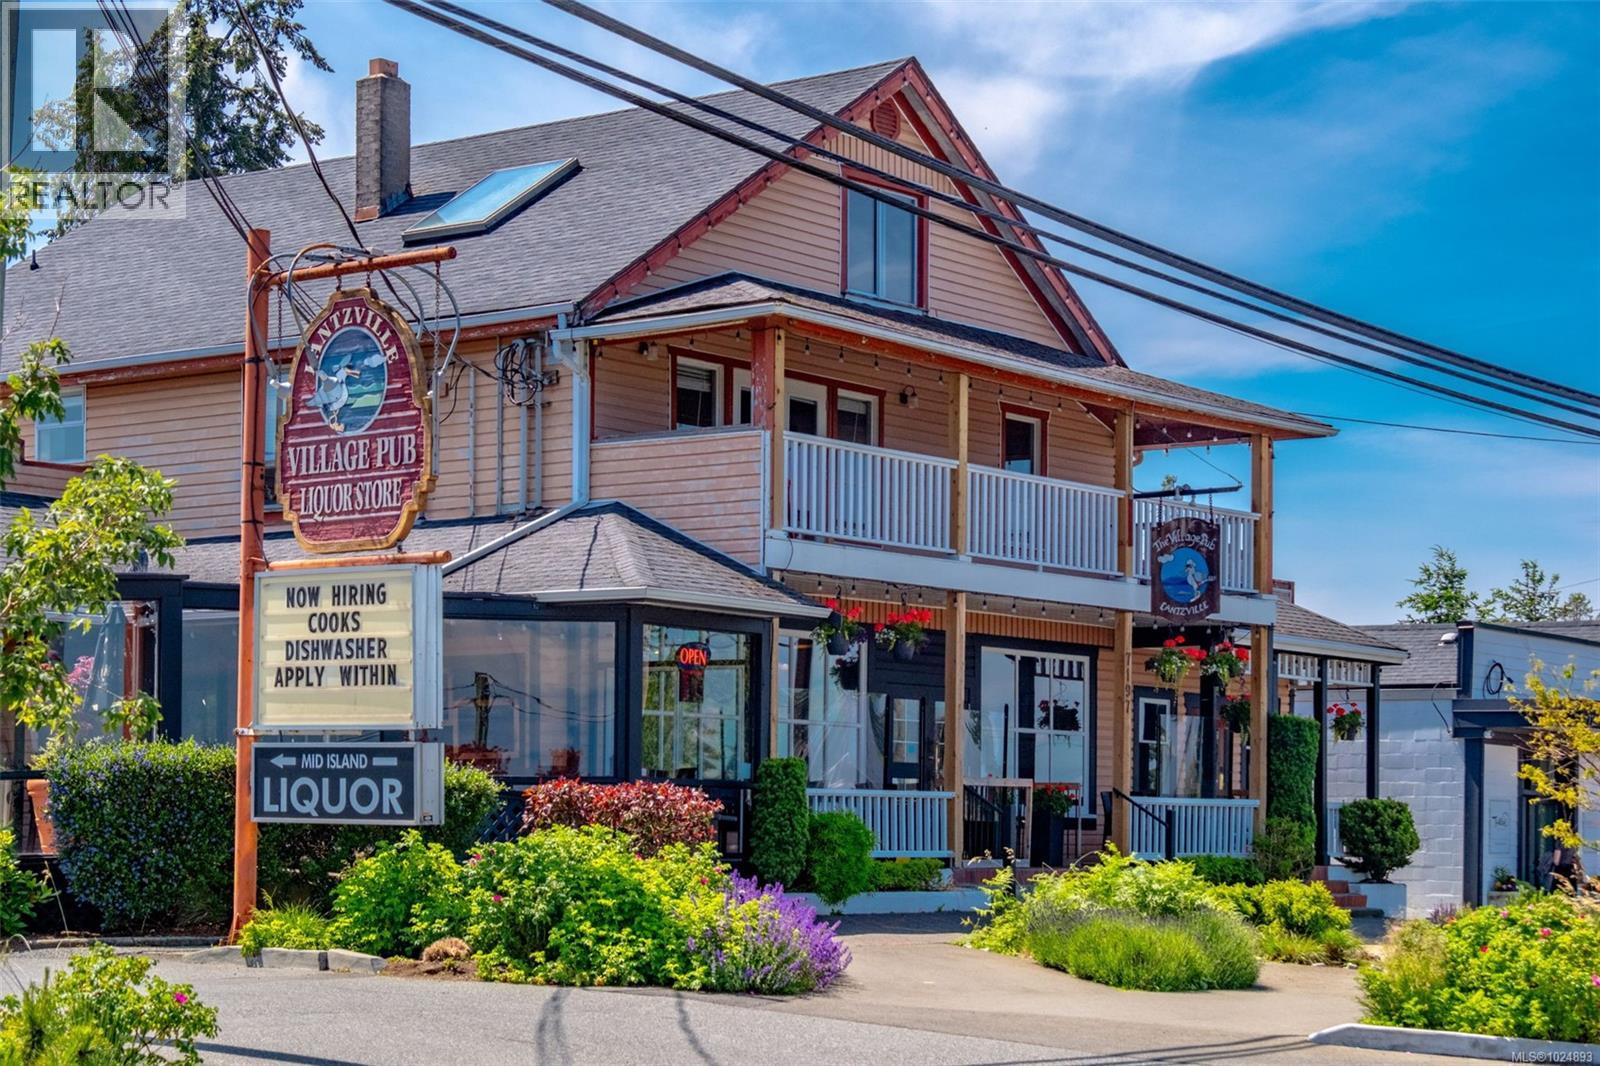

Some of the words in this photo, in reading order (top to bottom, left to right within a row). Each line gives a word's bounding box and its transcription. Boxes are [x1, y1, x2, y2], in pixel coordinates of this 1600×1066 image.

[287, 438, 370, 476] VILLAGE
[375, 434, 417, 468] PUB
[300, 483, 353, 521] LIQUOR
[355, 478, 402, 510] STORE
[1152, 537, 1169, 552] The
[1200, 533, 1217, 550] Pub
[286, 585, 320, 608] NOW
[332, 583, 387, 606] HIRING
[308, 611, 361, 633] COOKS
[285, 638, 388, 661] DISHWASHER
[680, 647, 707, 666] OPEN
[274, 666, 325, 687] APPLY
[340, 664, 397, 686] WITHIN
[301, 753, 324, 769] MID
[326, 753, 368, 769] ISLAND
[263, 777, 404, 817] LIQUOR
